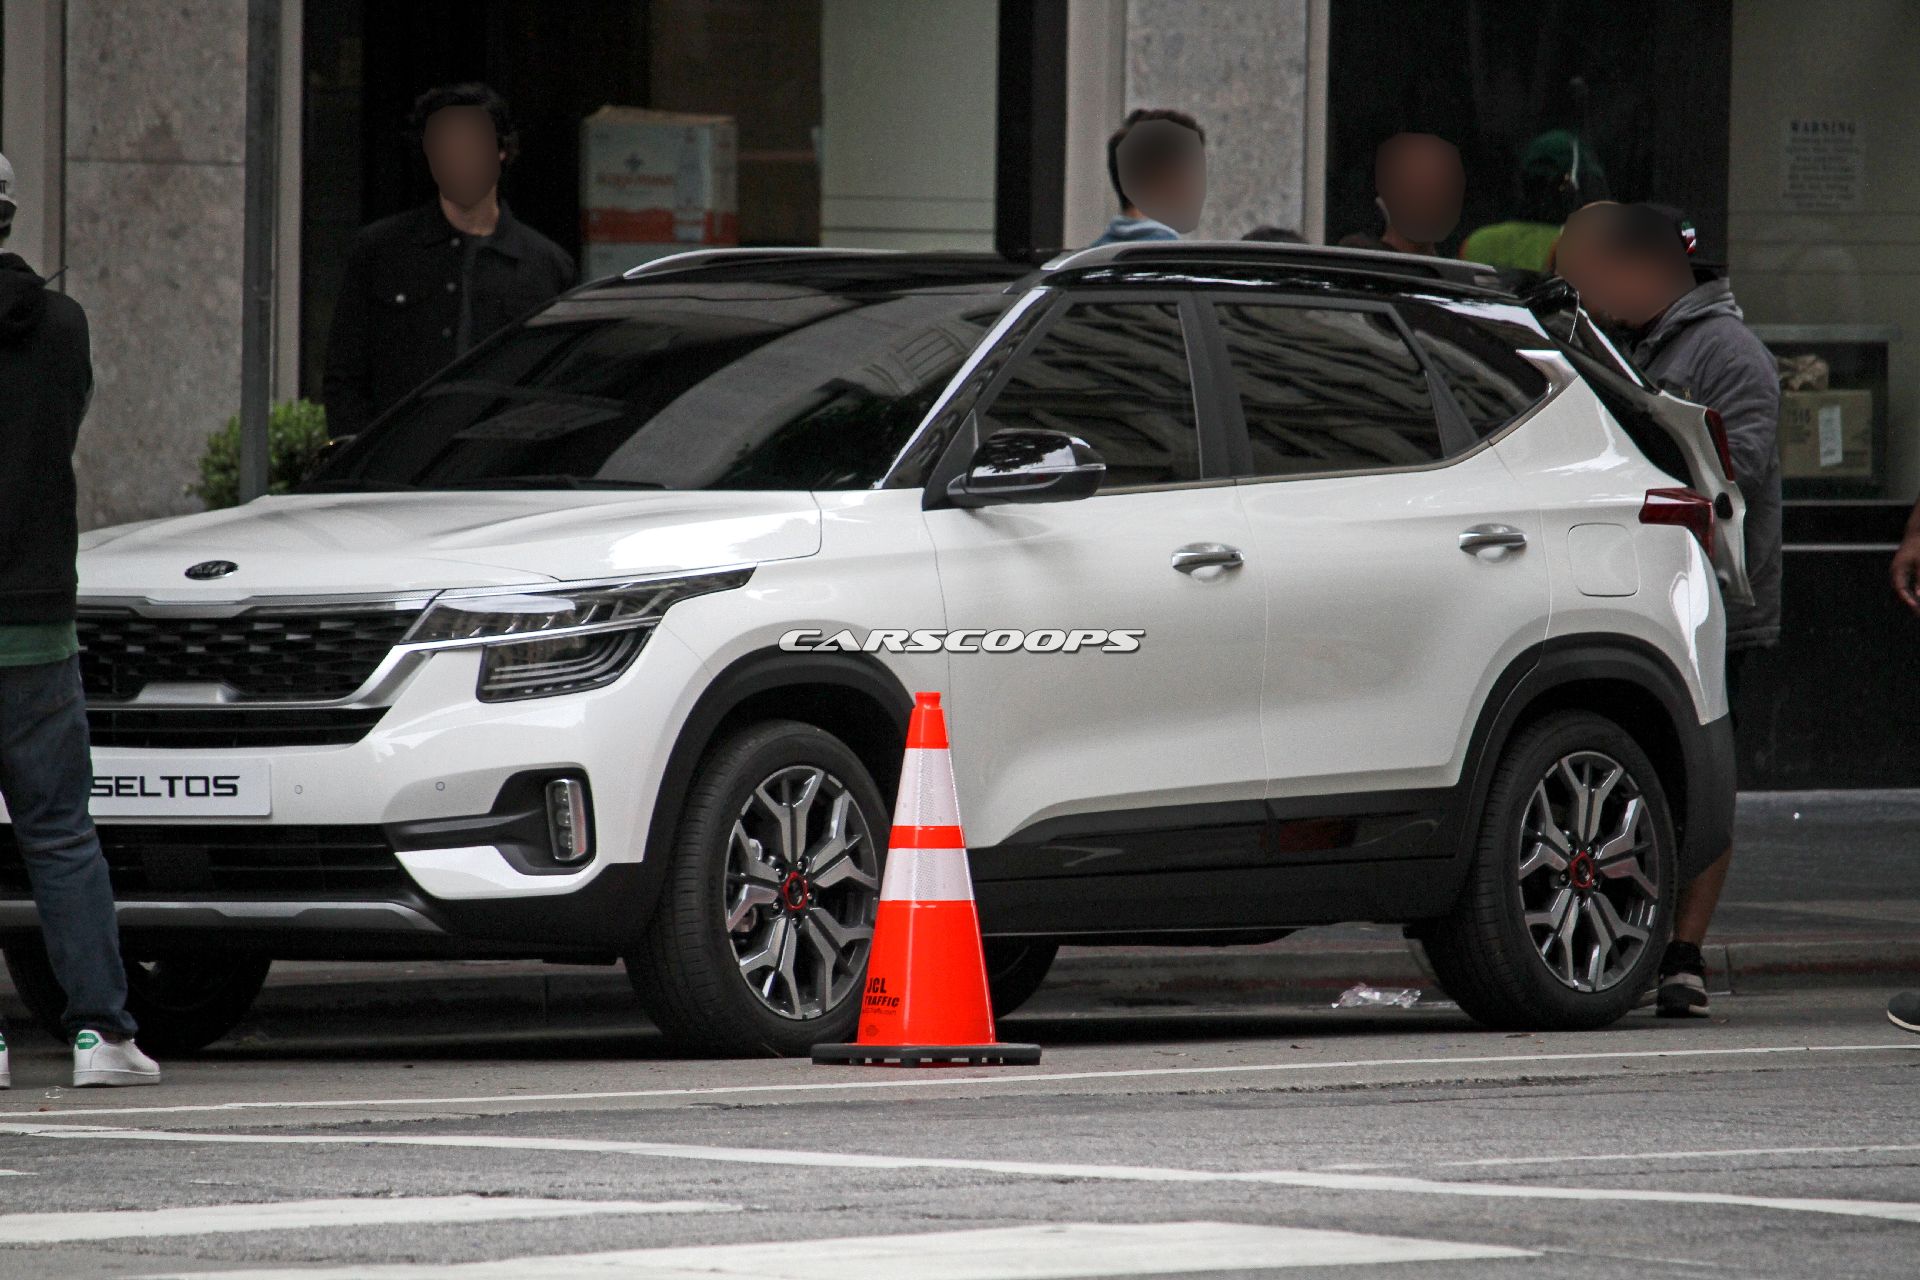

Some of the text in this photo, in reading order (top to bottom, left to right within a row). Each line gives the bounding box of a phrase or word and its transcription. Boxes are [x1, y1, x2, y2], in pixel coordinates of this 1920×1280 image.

[1791, 120, 1856, 134] WARNING
[91, 775, 240, 797] SELTOS
[867, 977, 887, 994] JCL
[865, 995, 900, 1008] TRAFFIC
